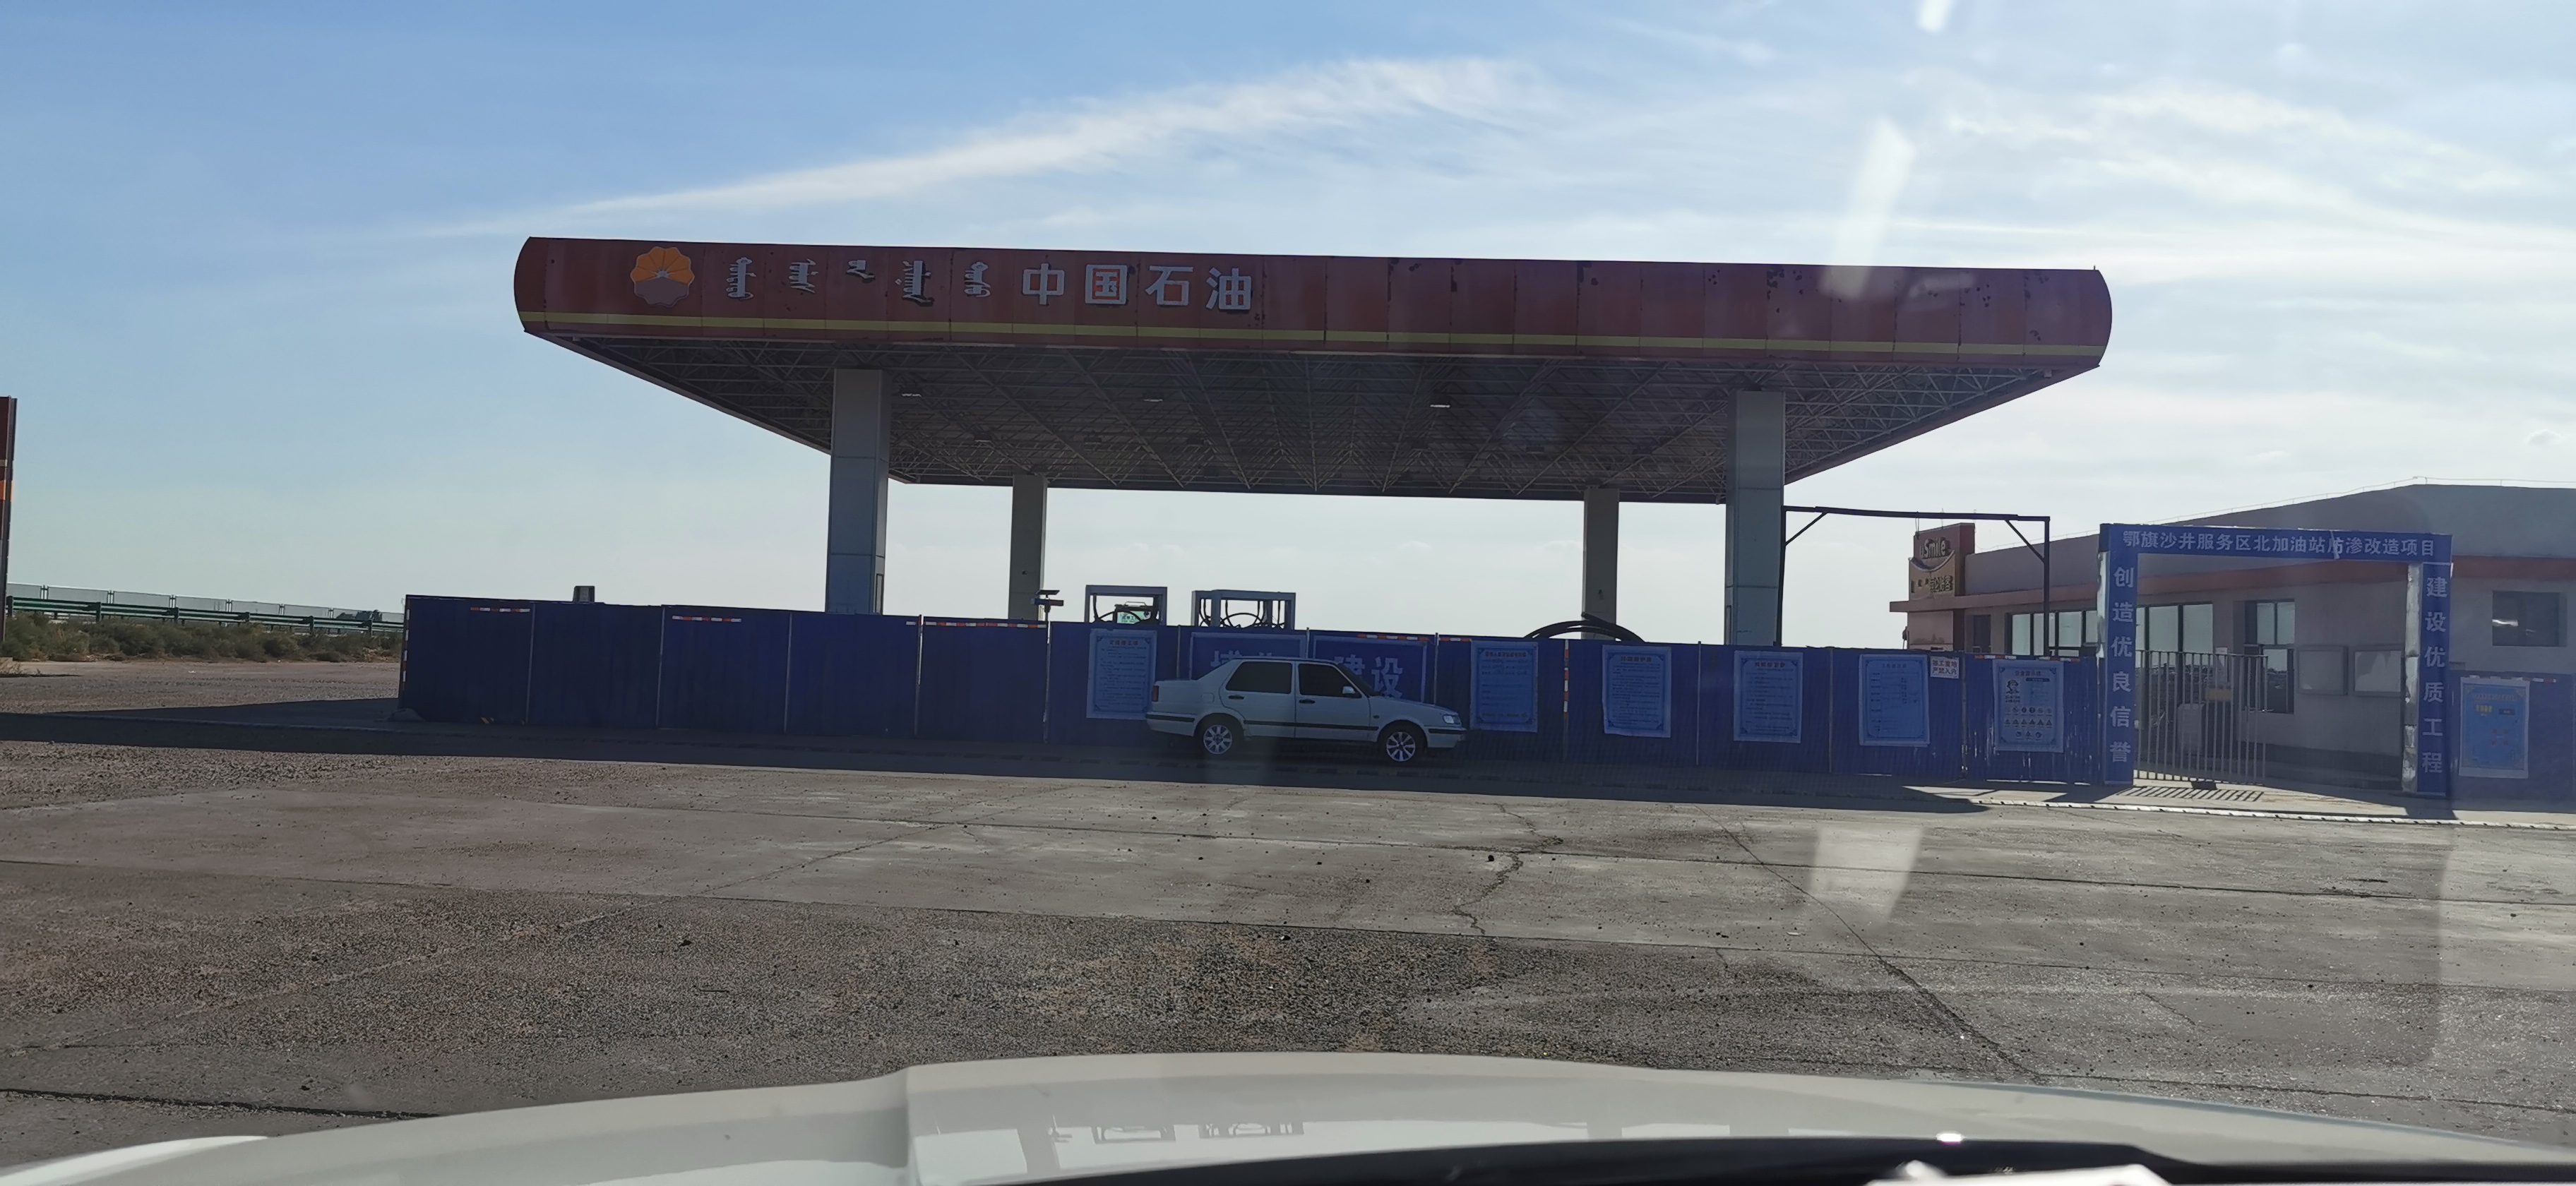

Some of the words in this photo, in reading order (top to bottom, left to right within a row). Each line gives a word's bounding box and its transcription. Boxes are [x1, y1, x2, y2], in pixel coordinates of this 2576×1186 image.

[1022, 262, 1253, 313] 中国石油
[2122, 529, 2435, 557] 鄂旗沙井服务区北加油站防渗改造项目
[2110, 566, 2135, 763] 创造优良信誉
[2421, 576, 2448, 774] 建设优质工程
